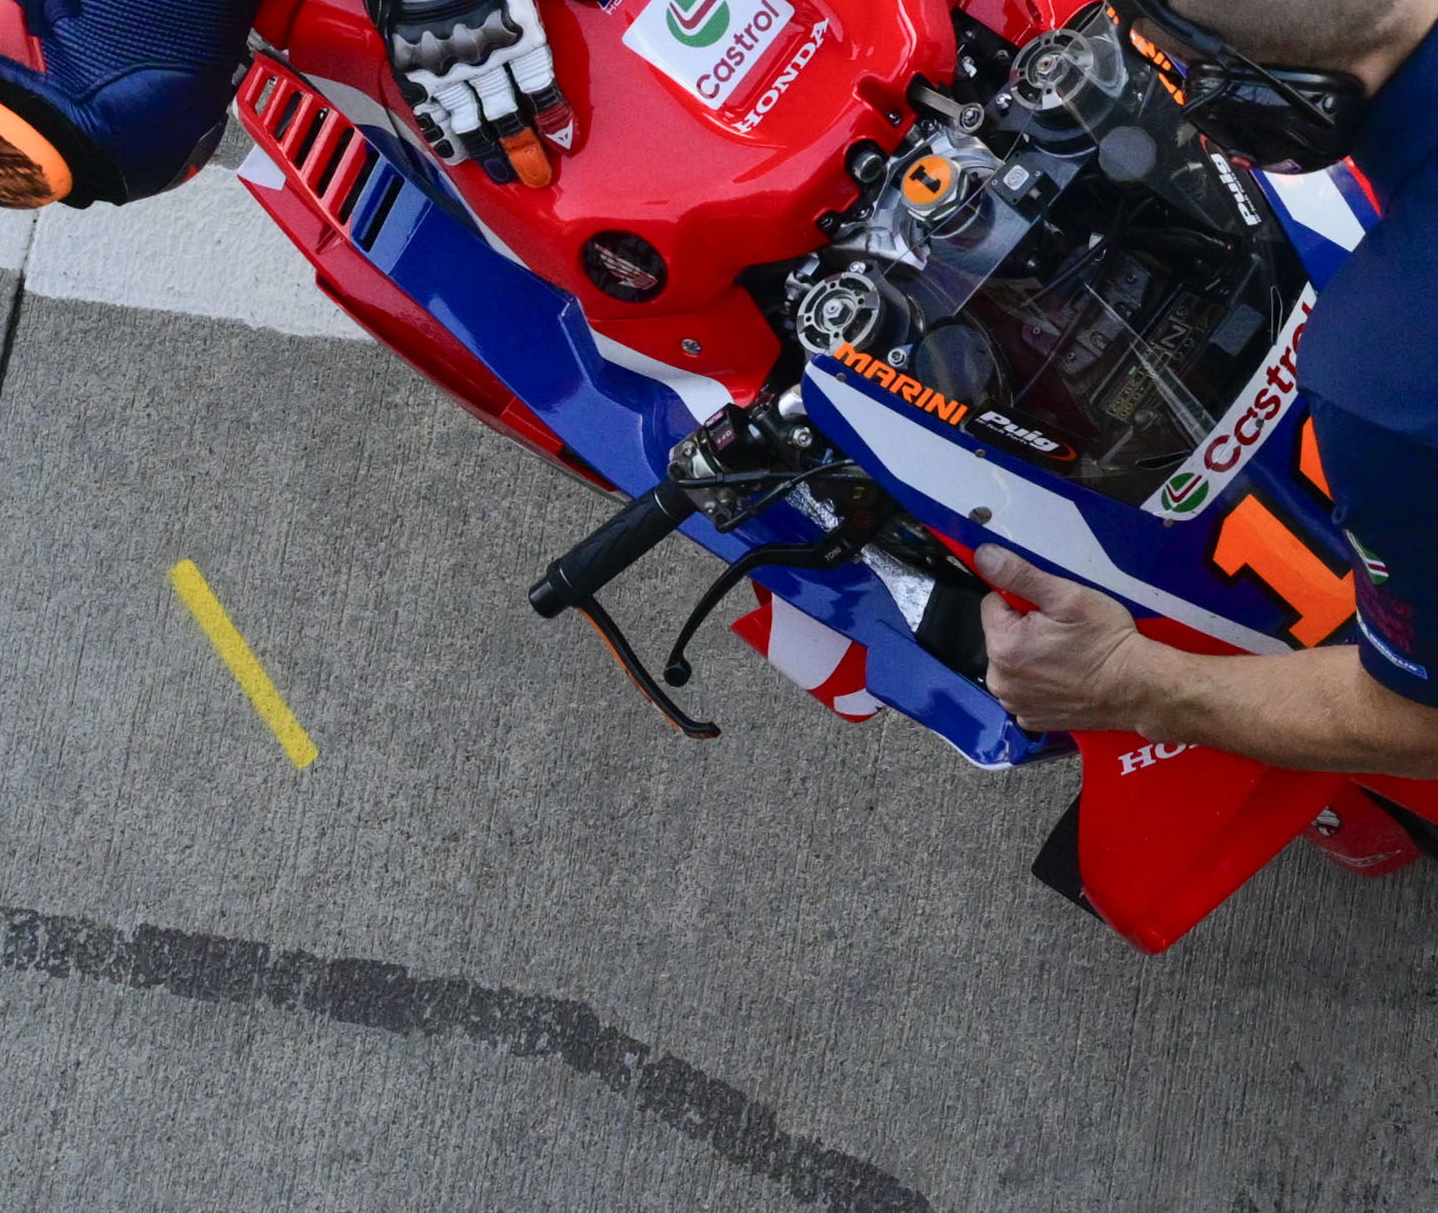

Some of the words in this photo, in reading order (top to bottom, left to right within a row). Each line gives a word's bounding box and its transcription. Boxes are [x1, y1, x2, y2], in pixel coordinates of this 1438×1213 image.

[732, 17, 830, 133] HONDA
[1210, 152, 1259, 226] Puig
[833, 341, 969, 426] MARINI
[979, 410, 1060, 452] Puig
